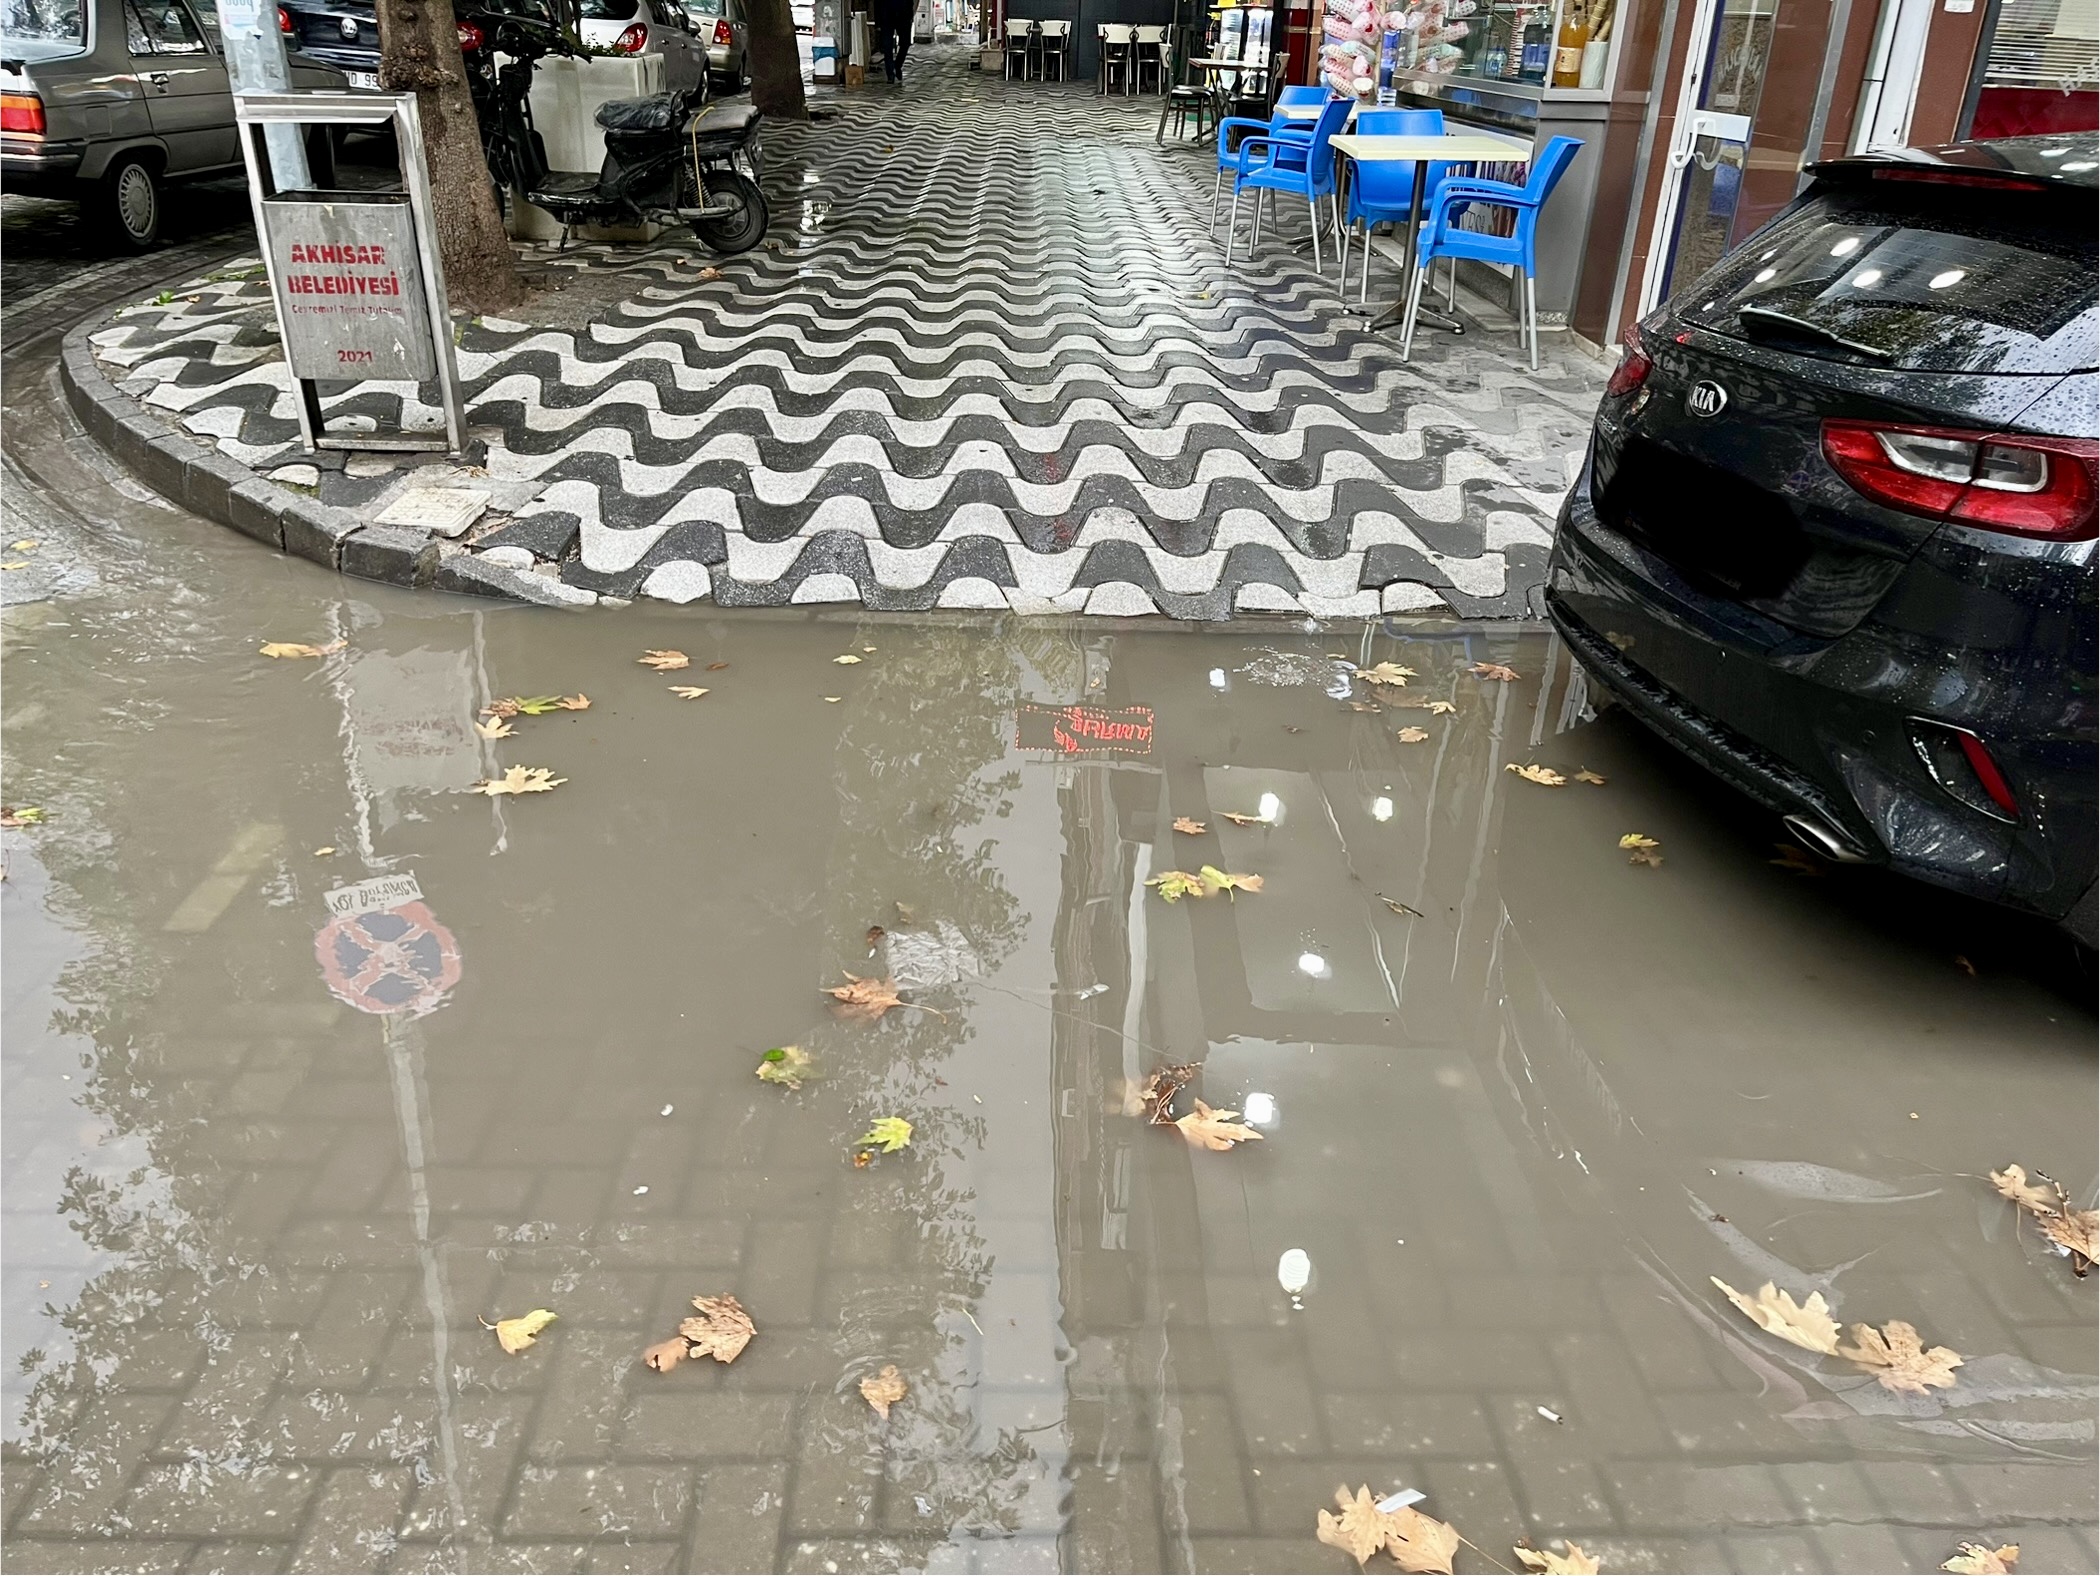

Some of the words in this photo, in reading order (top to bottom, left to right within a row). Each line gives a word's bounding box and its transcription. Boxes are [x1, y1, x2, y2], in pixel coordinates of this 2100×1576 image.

[291, 240, 385, 265] AKHİSAR
[287, 270, 399, 296] BELEDİYESİ
[337, 350, 373, 362] 2021
[1691, 385, 1716, 412] KIA
